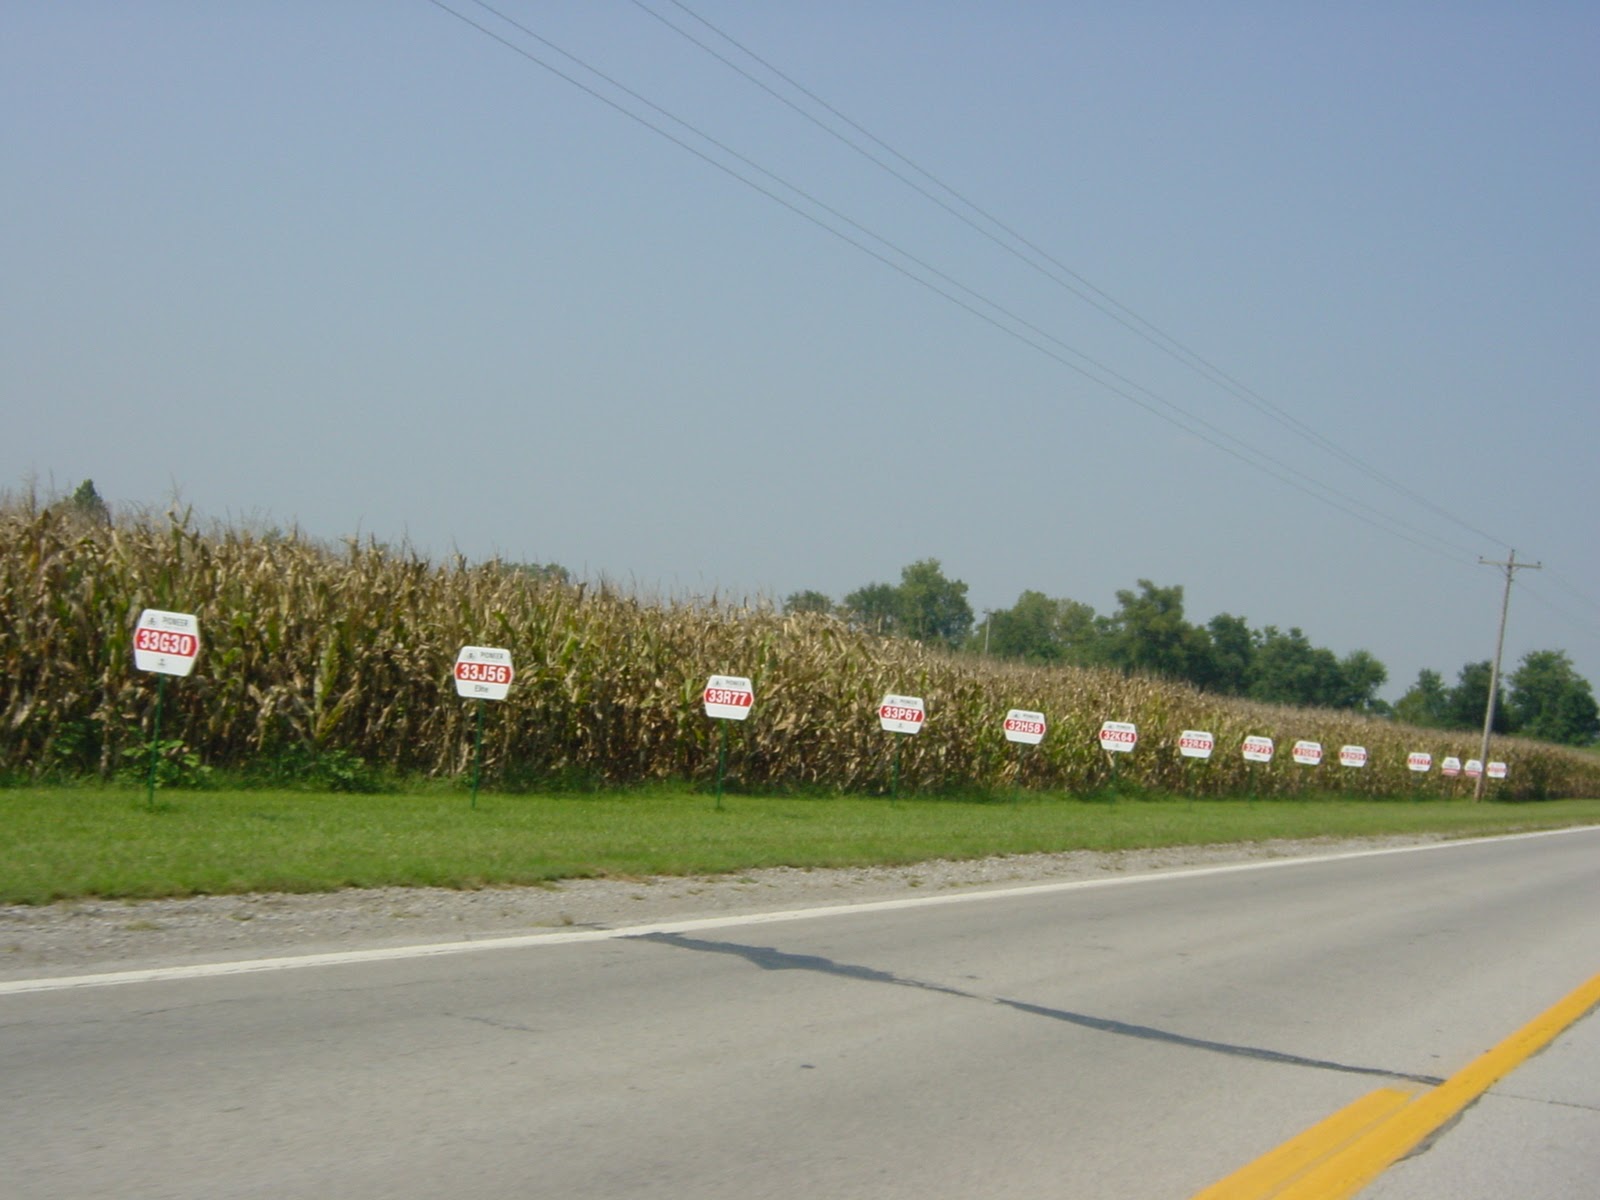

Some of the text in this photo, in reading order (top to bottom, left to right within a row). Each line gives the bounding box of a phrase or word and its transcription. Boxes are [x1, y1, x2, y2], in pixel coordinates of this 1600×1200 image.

[140, 630, 192, 655] 33G30
[460, 664, 507, 683] 33J56
[708, 690, 748, 705] 33R77
[884, 707, 919, 721] 33P67
[1008, 720, 1041, 733] 32H58
[1103, 730, 1133, 742] 32K64
